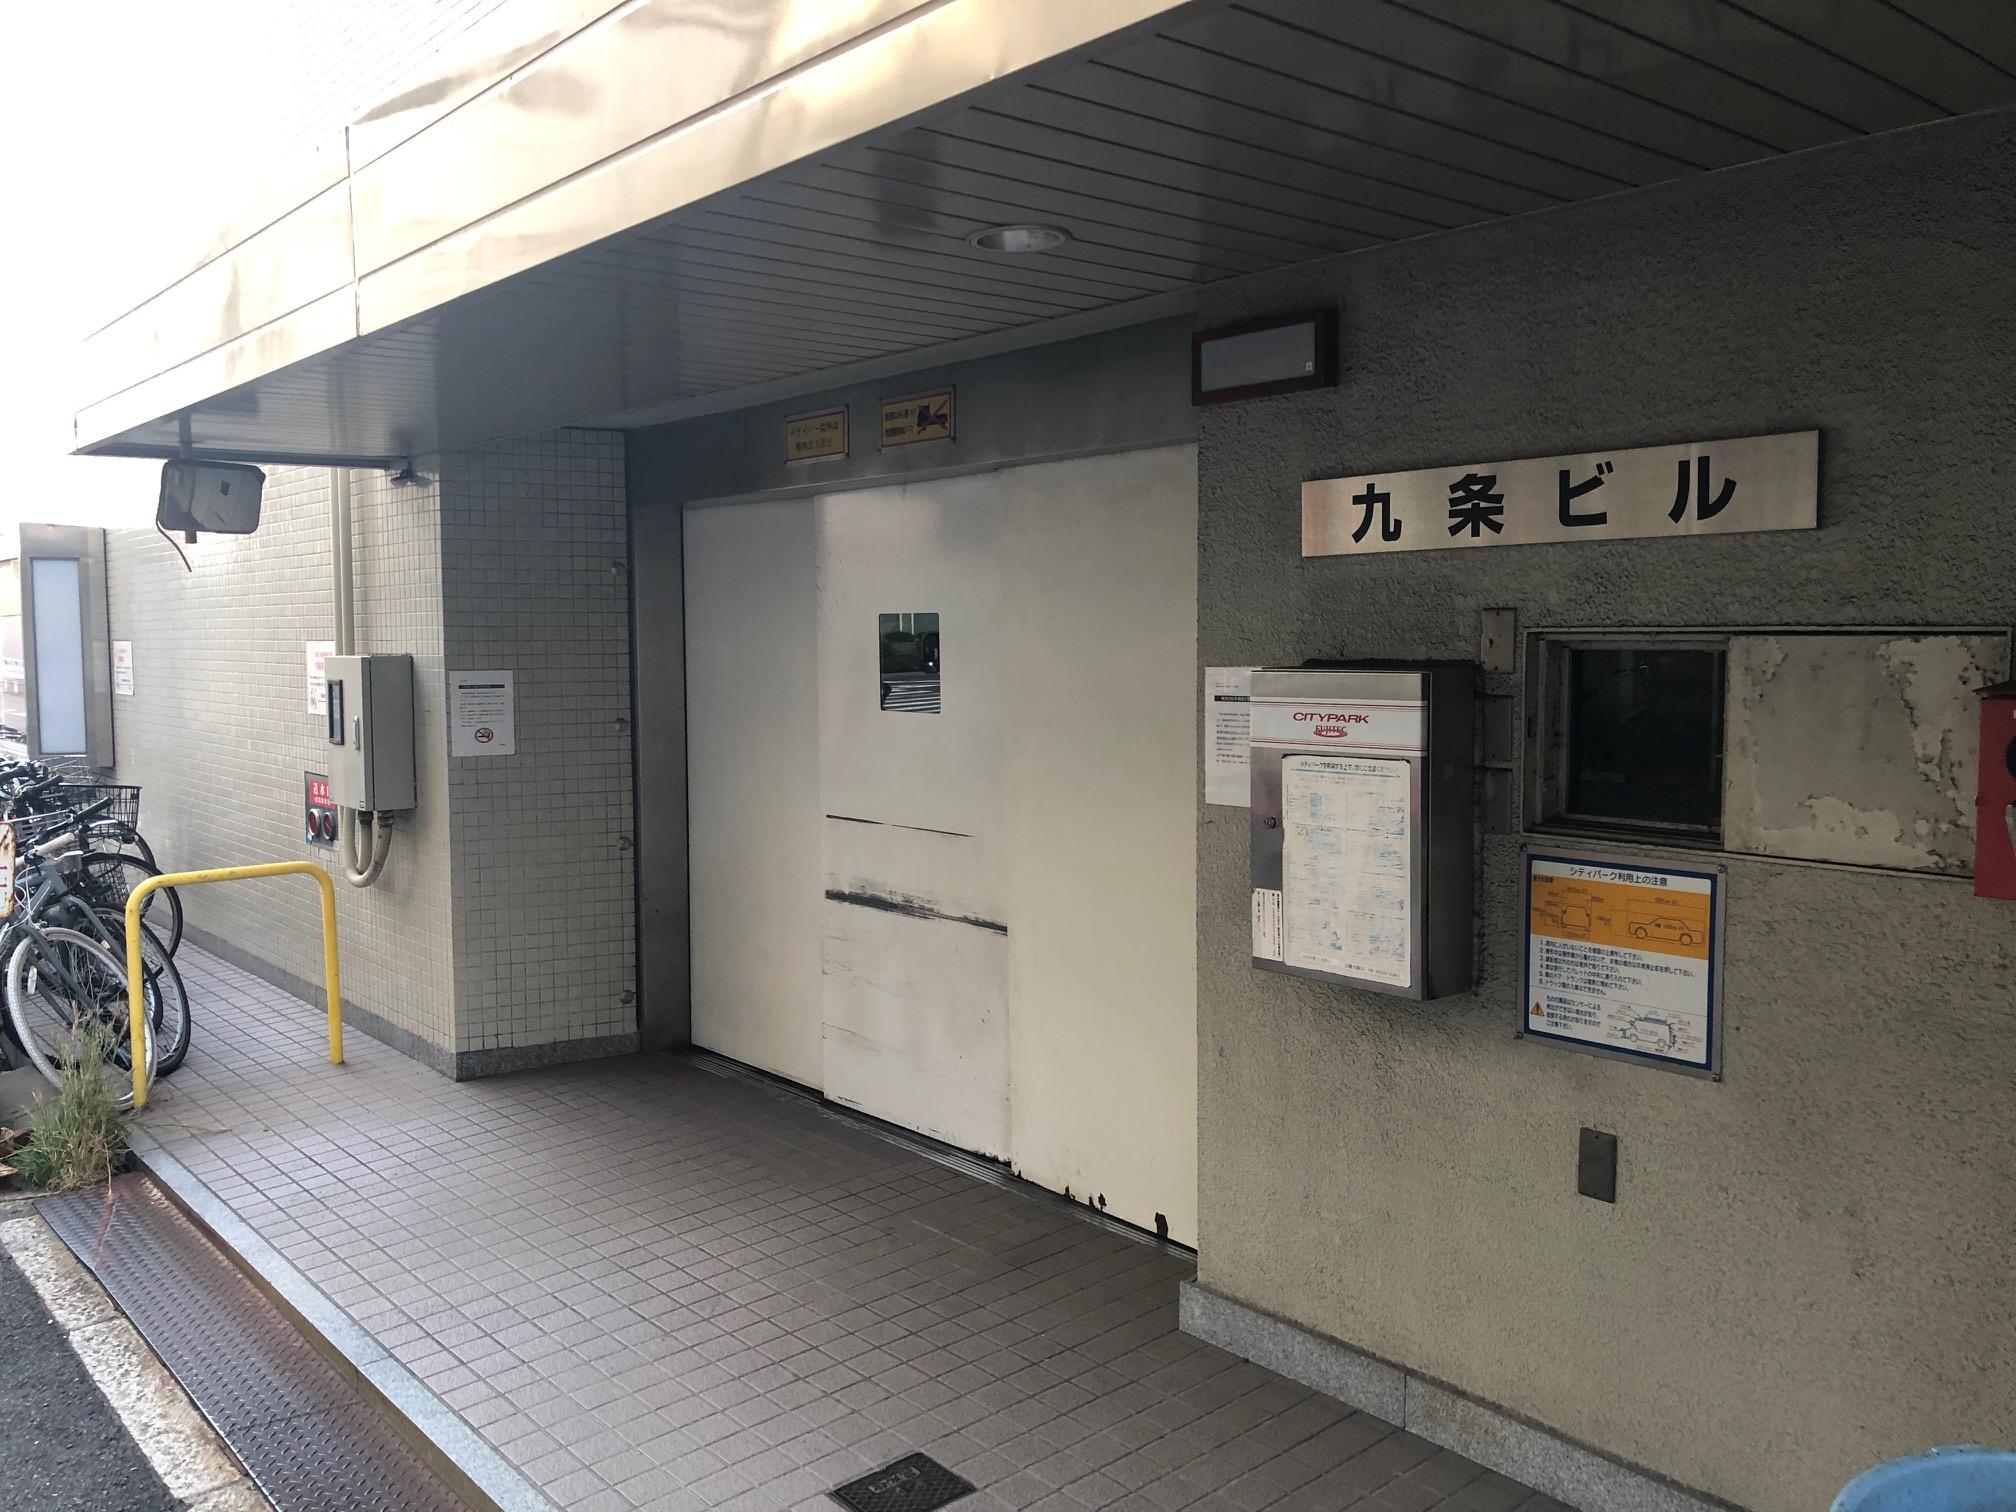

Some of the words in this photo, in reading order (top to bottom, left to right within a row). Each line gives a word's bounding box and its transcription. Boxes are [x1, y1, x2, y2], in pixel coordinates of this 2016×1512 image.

[1351, 455, 1737, 544] 九条ビル
[1293, 712, 1370, 724] CITYPARK
[1568, 866, 1668, 887] シティパーク利用上の注意
